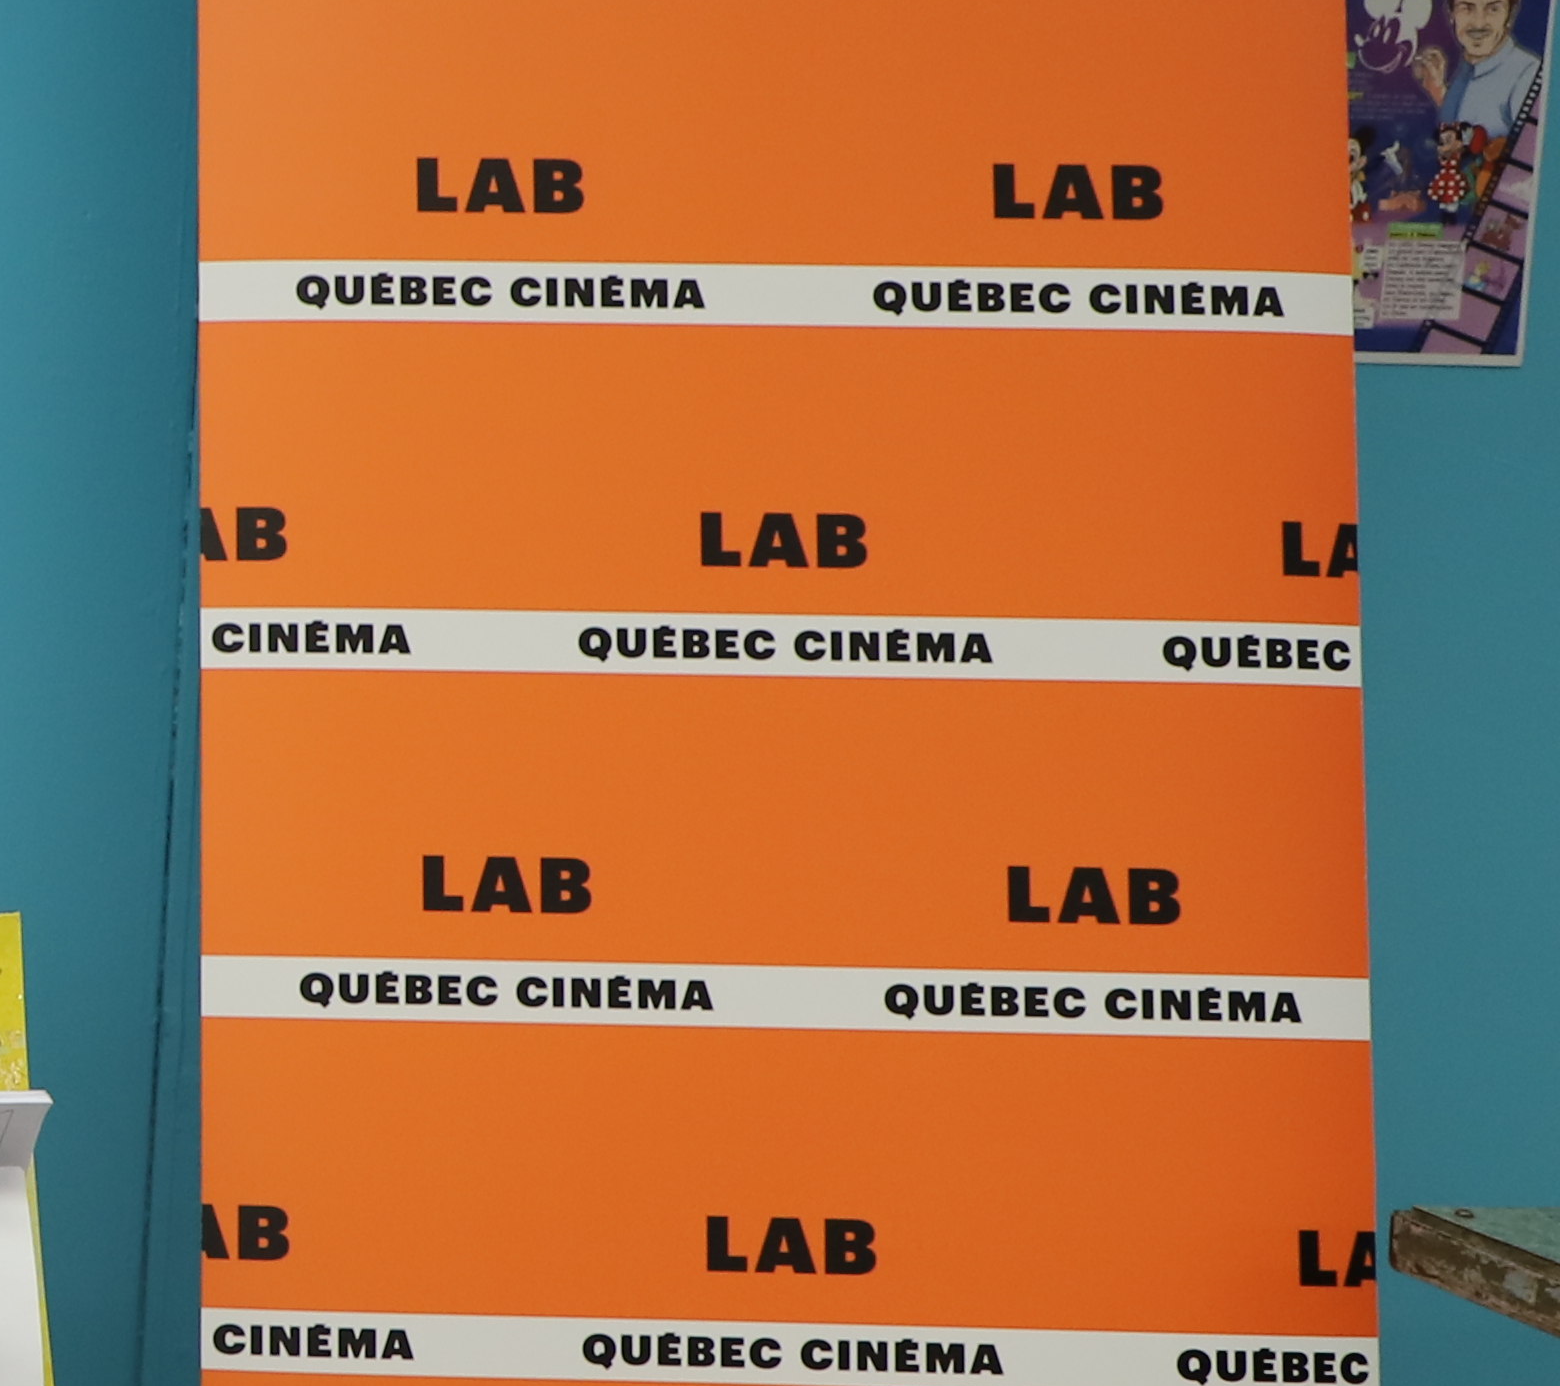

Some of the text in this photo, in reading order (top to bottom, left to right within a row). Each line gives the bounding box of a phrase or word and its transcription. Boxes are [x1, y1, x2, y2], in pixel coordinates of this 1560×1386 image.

[418, 157, 583, 213] LAB
[993, 163, 1163, 220] LAB
[296, 272, 705, 309] QUÉBEC CINÉMA
[873, 278, 1284, 317] QUÉBEC CINÉMA
[201, 507, 286, 561] AB
[701, 511, 867, 568] LAB
[1283, 520, 1359, 578] LA
[212, 619, 411, 654] CINÉMA
[578, 624, 992, 663] QUÉBEC CINÉMA
[1163, 633, 1350, 671] QUÉBEC
[423, 855, 591, 913] LAB
[1009, 865, 1180, 925] LAB
[299, 970, 713, 1010] QUÉBEC CINÉMA
[884, 981, 1302, 1023] QUÉBEC CINÉMA
[201, 1202, 289, 1260] AB
[707, 1215, 876, 1275] LAB
[1299, 1229, 1377, 1287] LA
[213, 1323, 414, 1360] CINÉMA
[582, 1331, 1003, 1375] QUÉBEC CINÉMA
[1177, 1347, 1369, 1386] QUÉBEC
